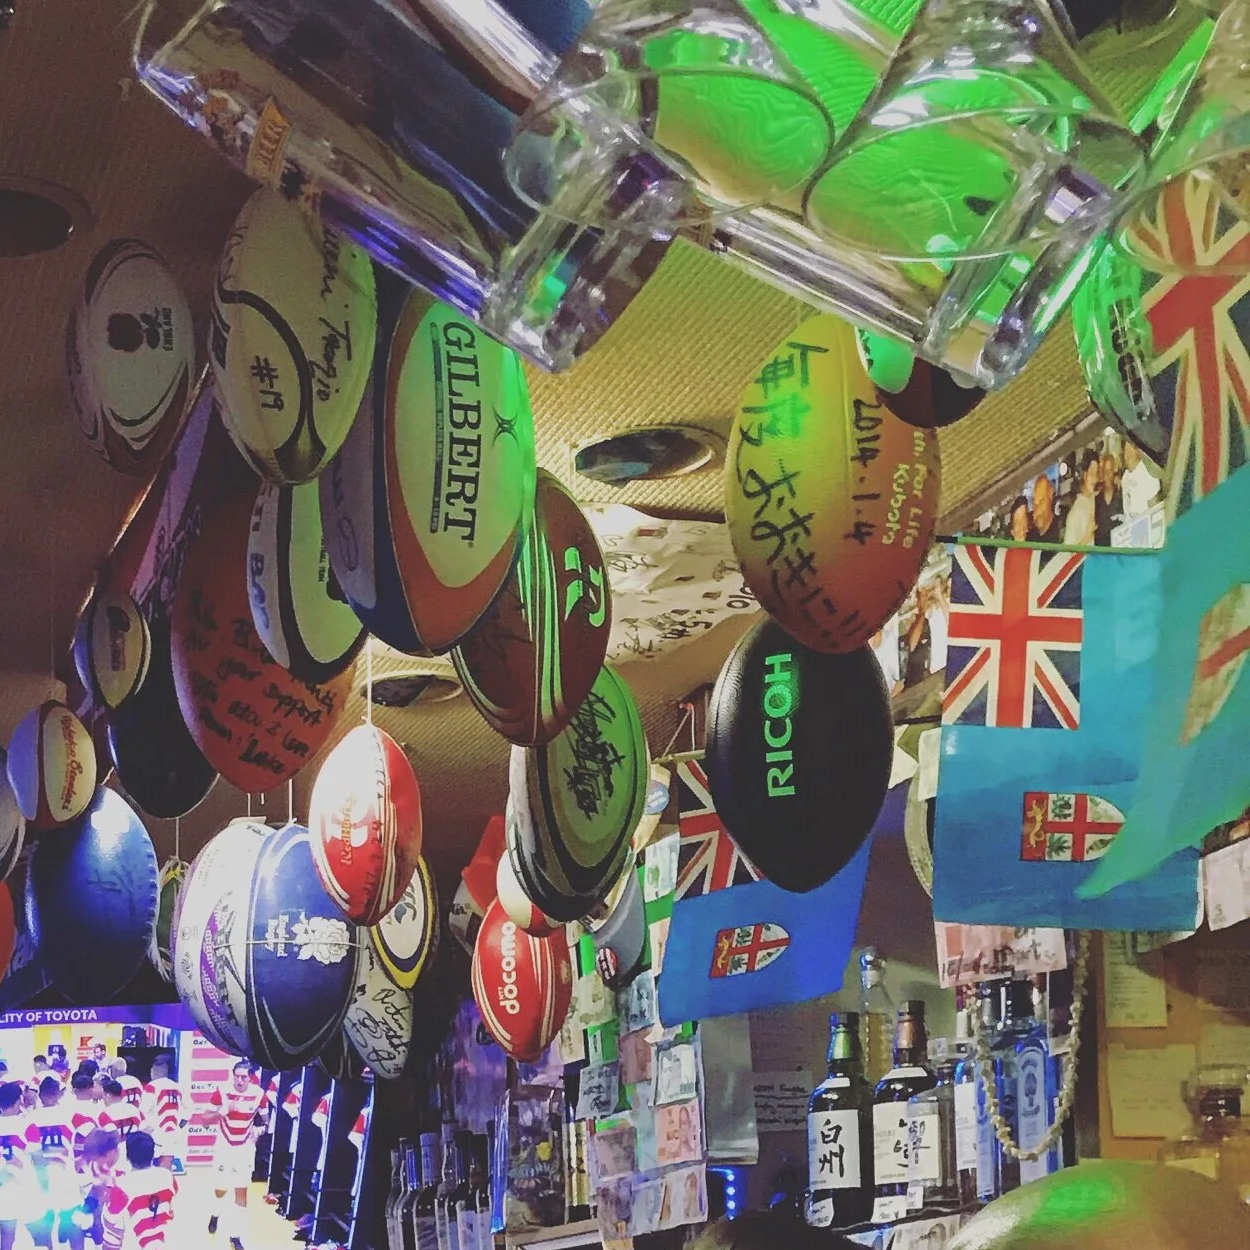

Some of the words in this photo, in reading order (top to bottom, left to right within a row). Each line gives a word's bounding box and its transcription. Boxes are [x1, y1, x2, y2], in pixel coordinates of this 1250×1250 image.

[443, 321, 482, 543] GILBERT
[764, 653, 796, 798] RICOH
[500, 921, 520, 1015] docomo
[25, 1011, 42, 1023] OF
[45, 1009, 98, 1022] TOYOTA
[818, 1118, 846, 1178] 白州
